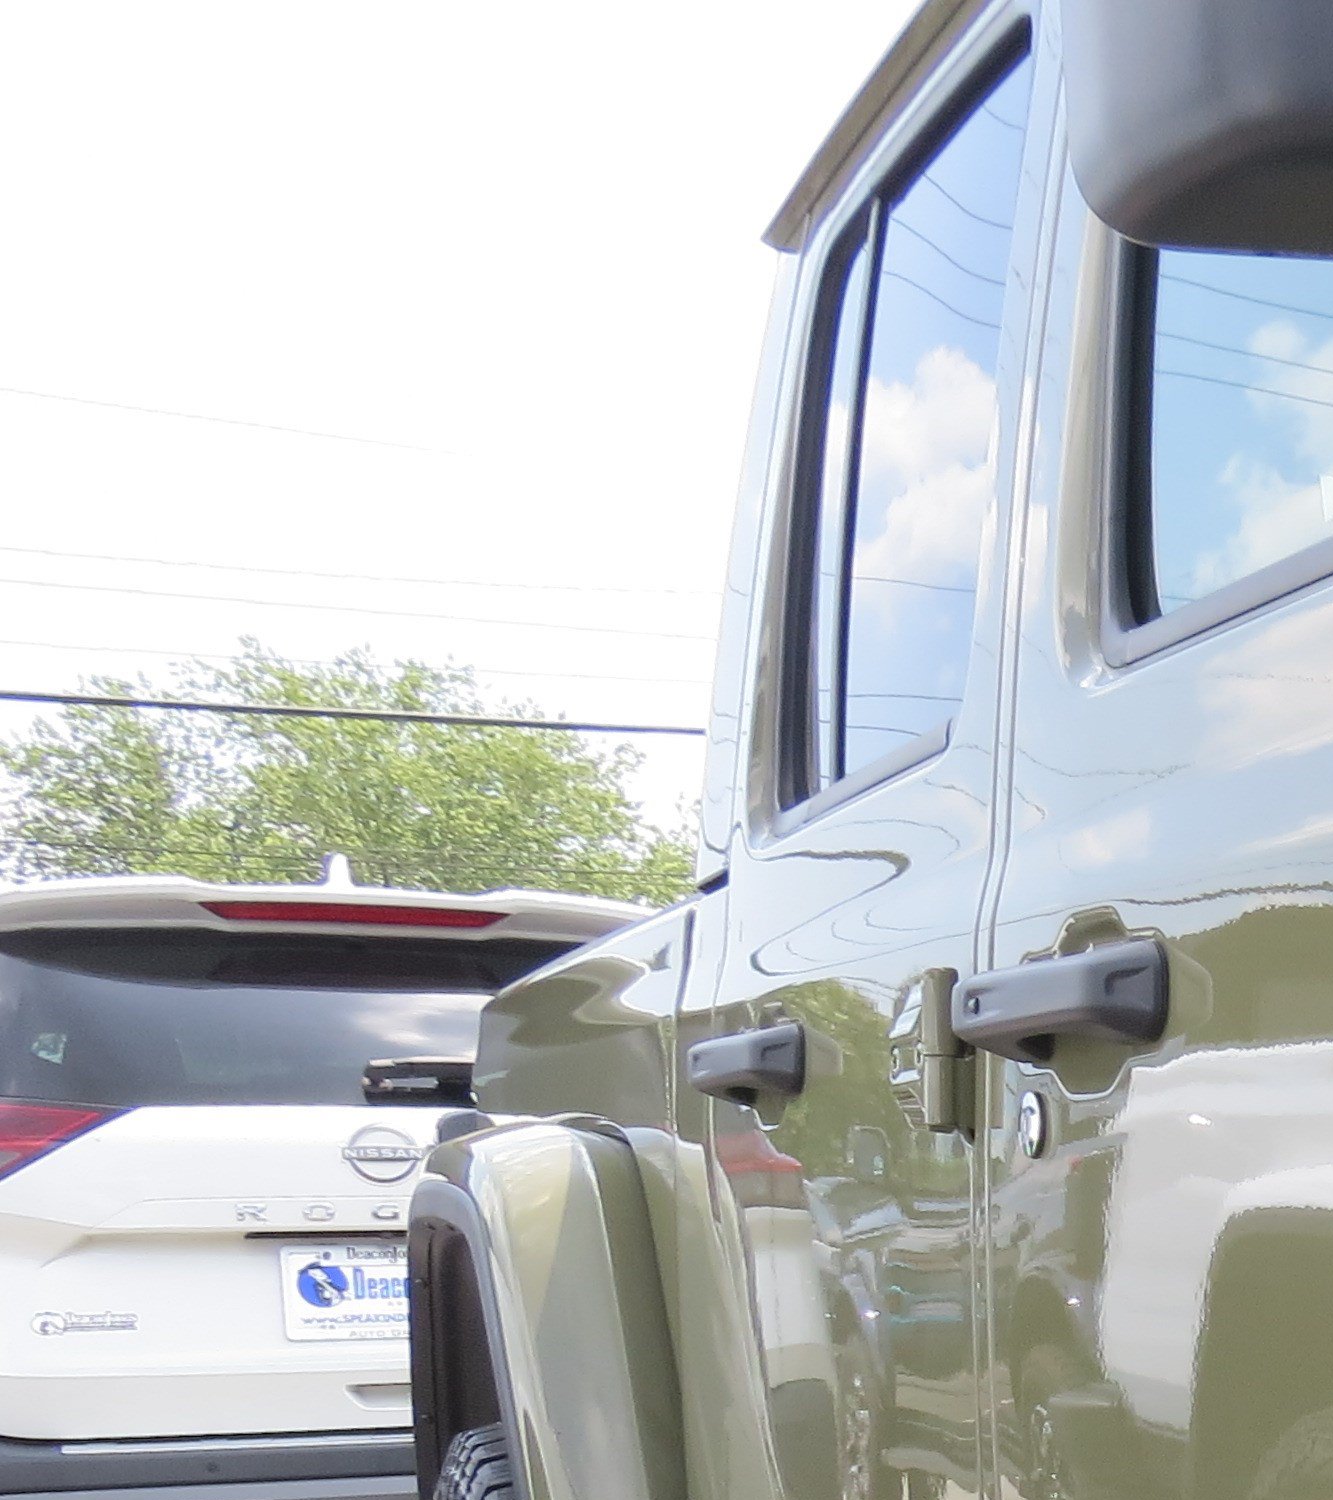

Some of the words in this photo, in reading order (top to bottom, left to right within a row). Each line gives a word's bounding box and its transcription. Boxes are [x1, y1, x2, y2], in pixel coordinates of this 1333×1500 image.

[344, 1148, 423, 1159] NISSAN
[235, 1202, 400, 1222] ROG
[346, 1246, 409, 1263] DeaconJo
